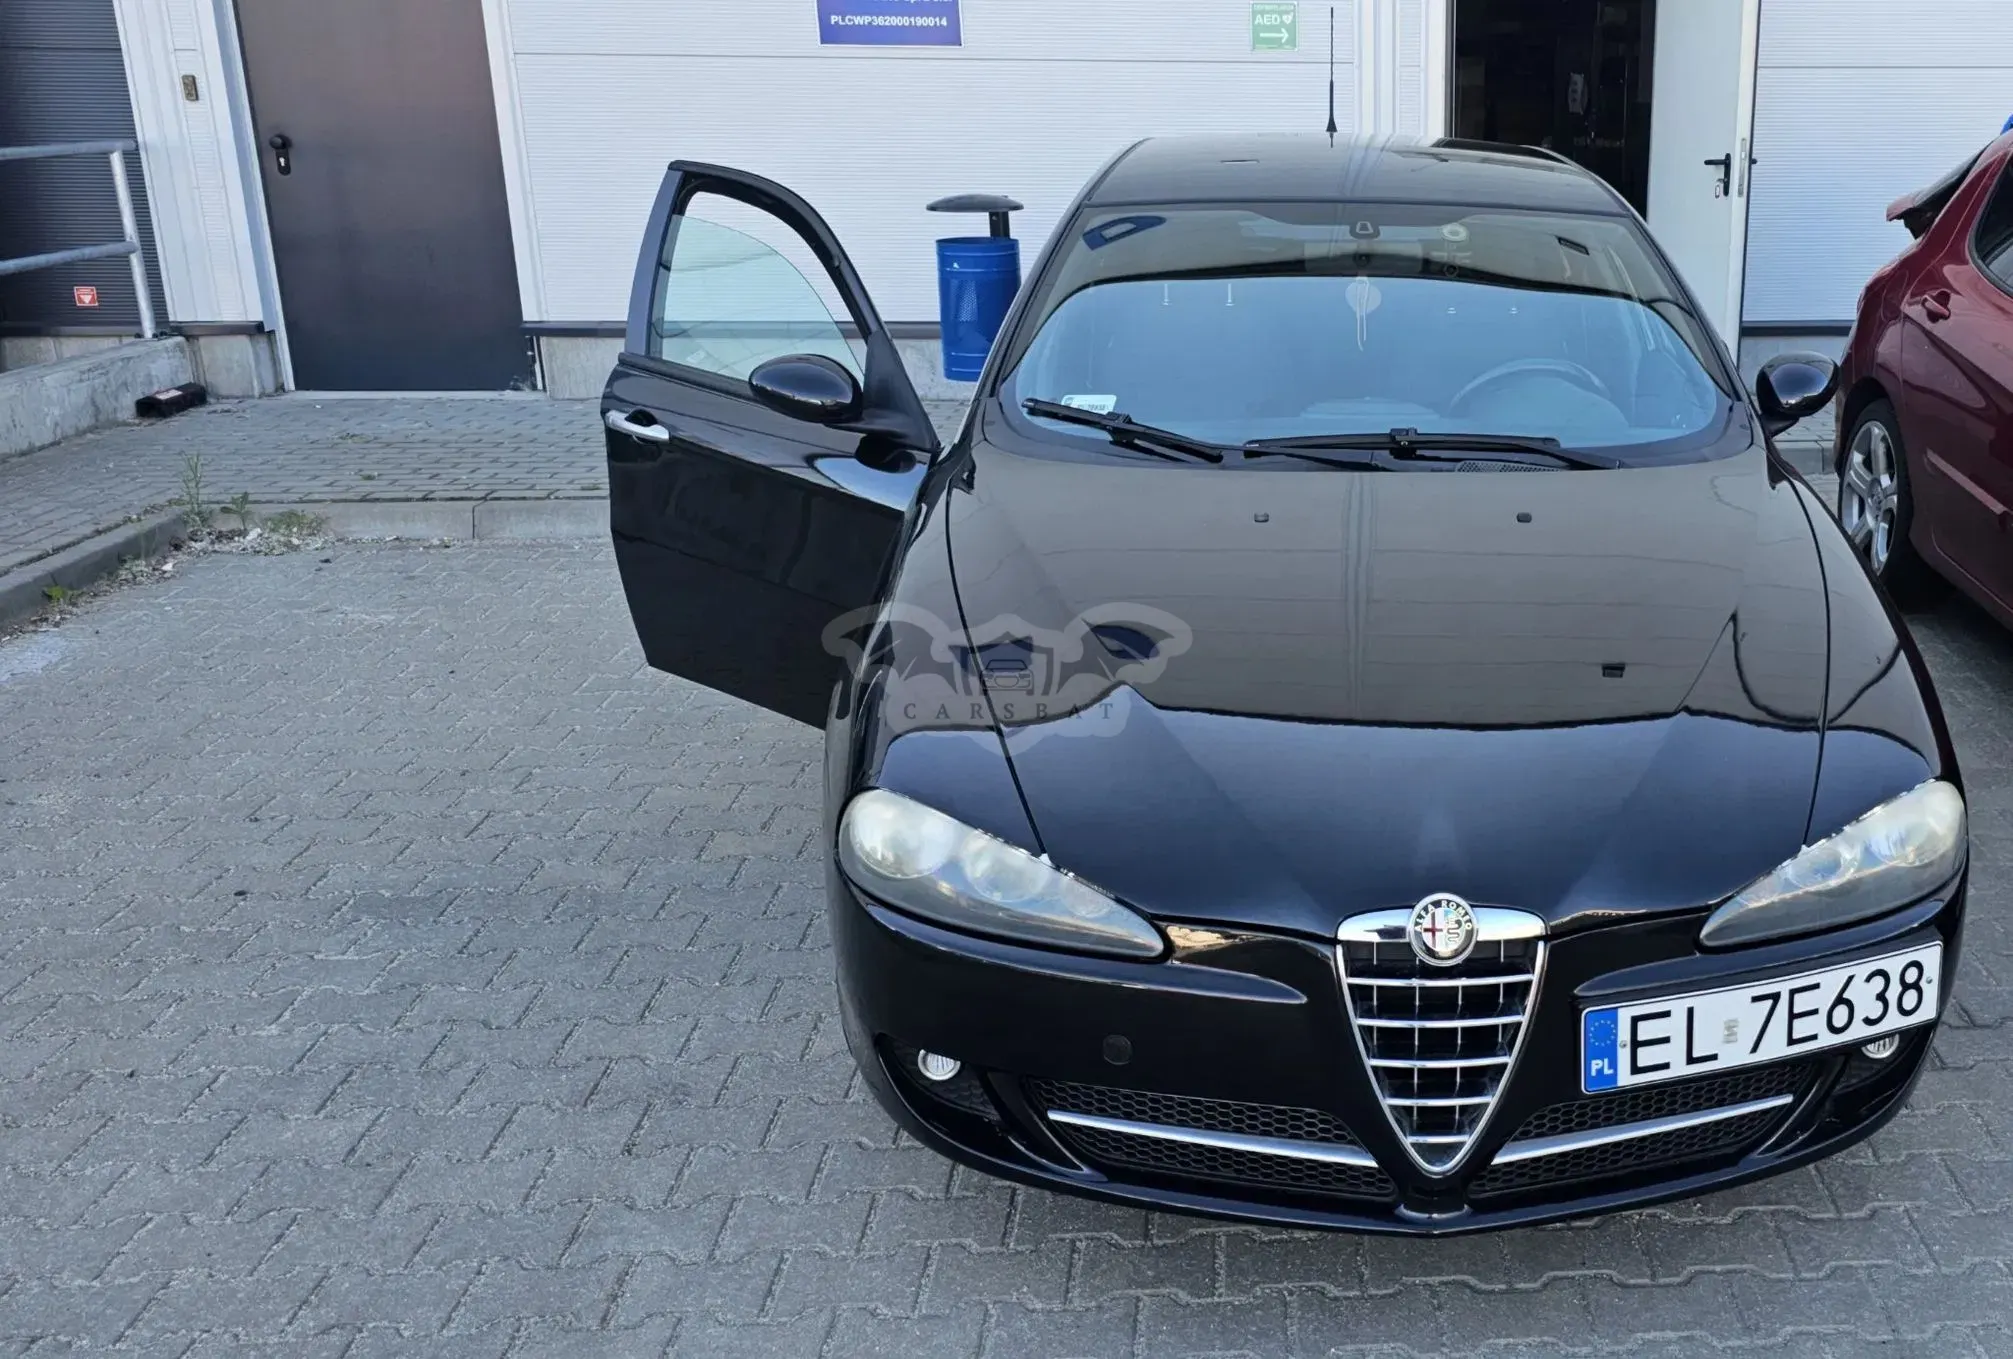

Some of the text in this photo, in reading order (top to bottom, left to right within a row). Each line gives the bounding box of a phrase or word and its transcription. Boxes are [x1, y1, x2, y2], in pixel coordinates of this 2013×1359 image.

[831, 15, 947, 27] PLCWP362000190014
[1254, 14, 1280, 25] AED
[1414, 903, 1436, 932] ALFA
[1630, 960, 1924, 1075] EL 7E638
[1591, 1058, 1614, 1076] PL
